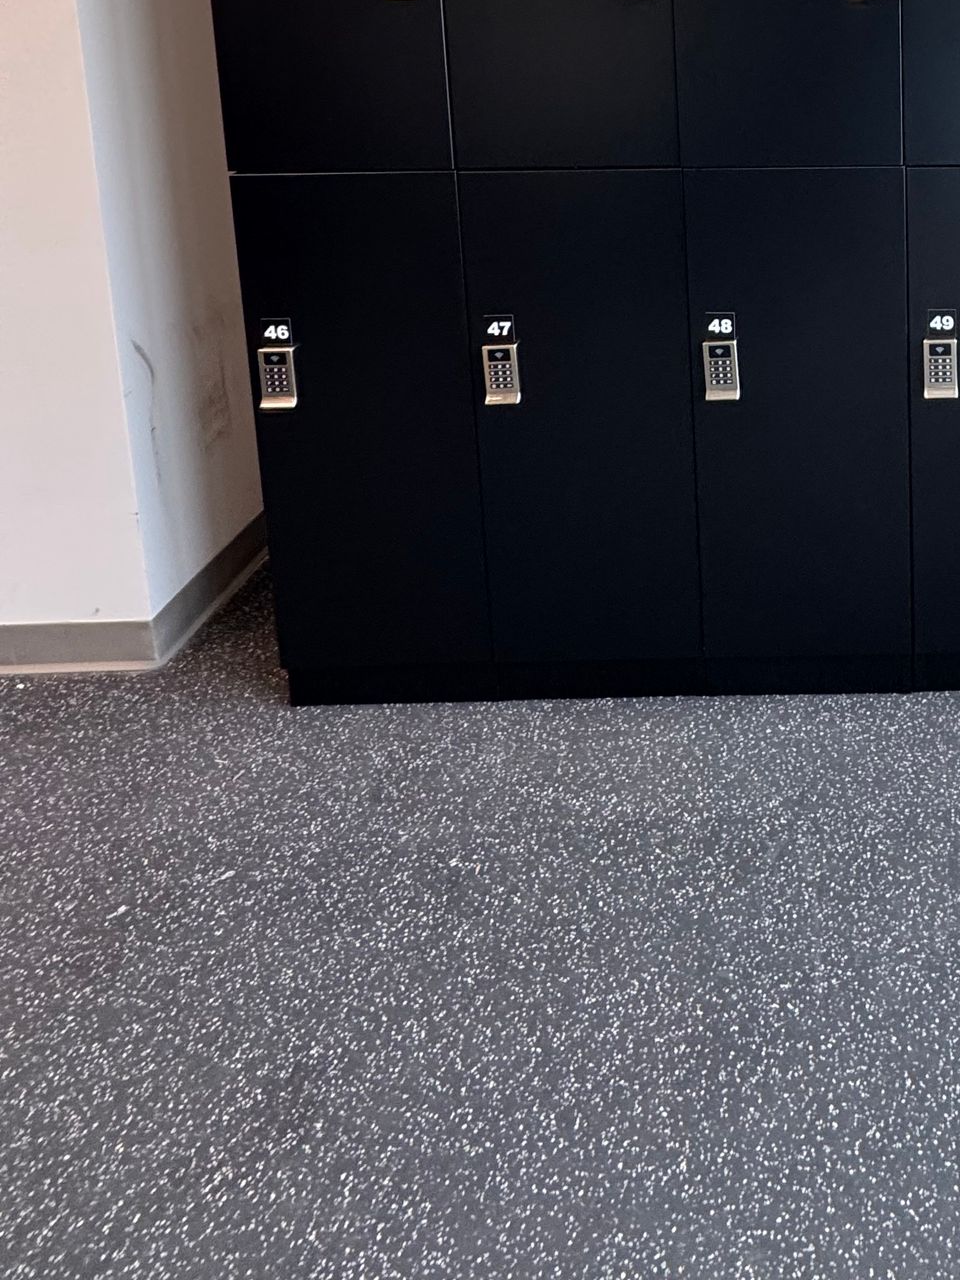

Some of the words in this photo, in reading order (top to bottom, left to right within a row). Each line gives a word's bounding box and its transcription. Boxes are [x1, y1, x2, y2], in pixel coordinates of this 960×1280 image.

[488, 322, 512, 336] 47
[708, 319, 733, 334] 48
[930, 315, 954, 330] 49
[264, 325, 290, 341] 46
